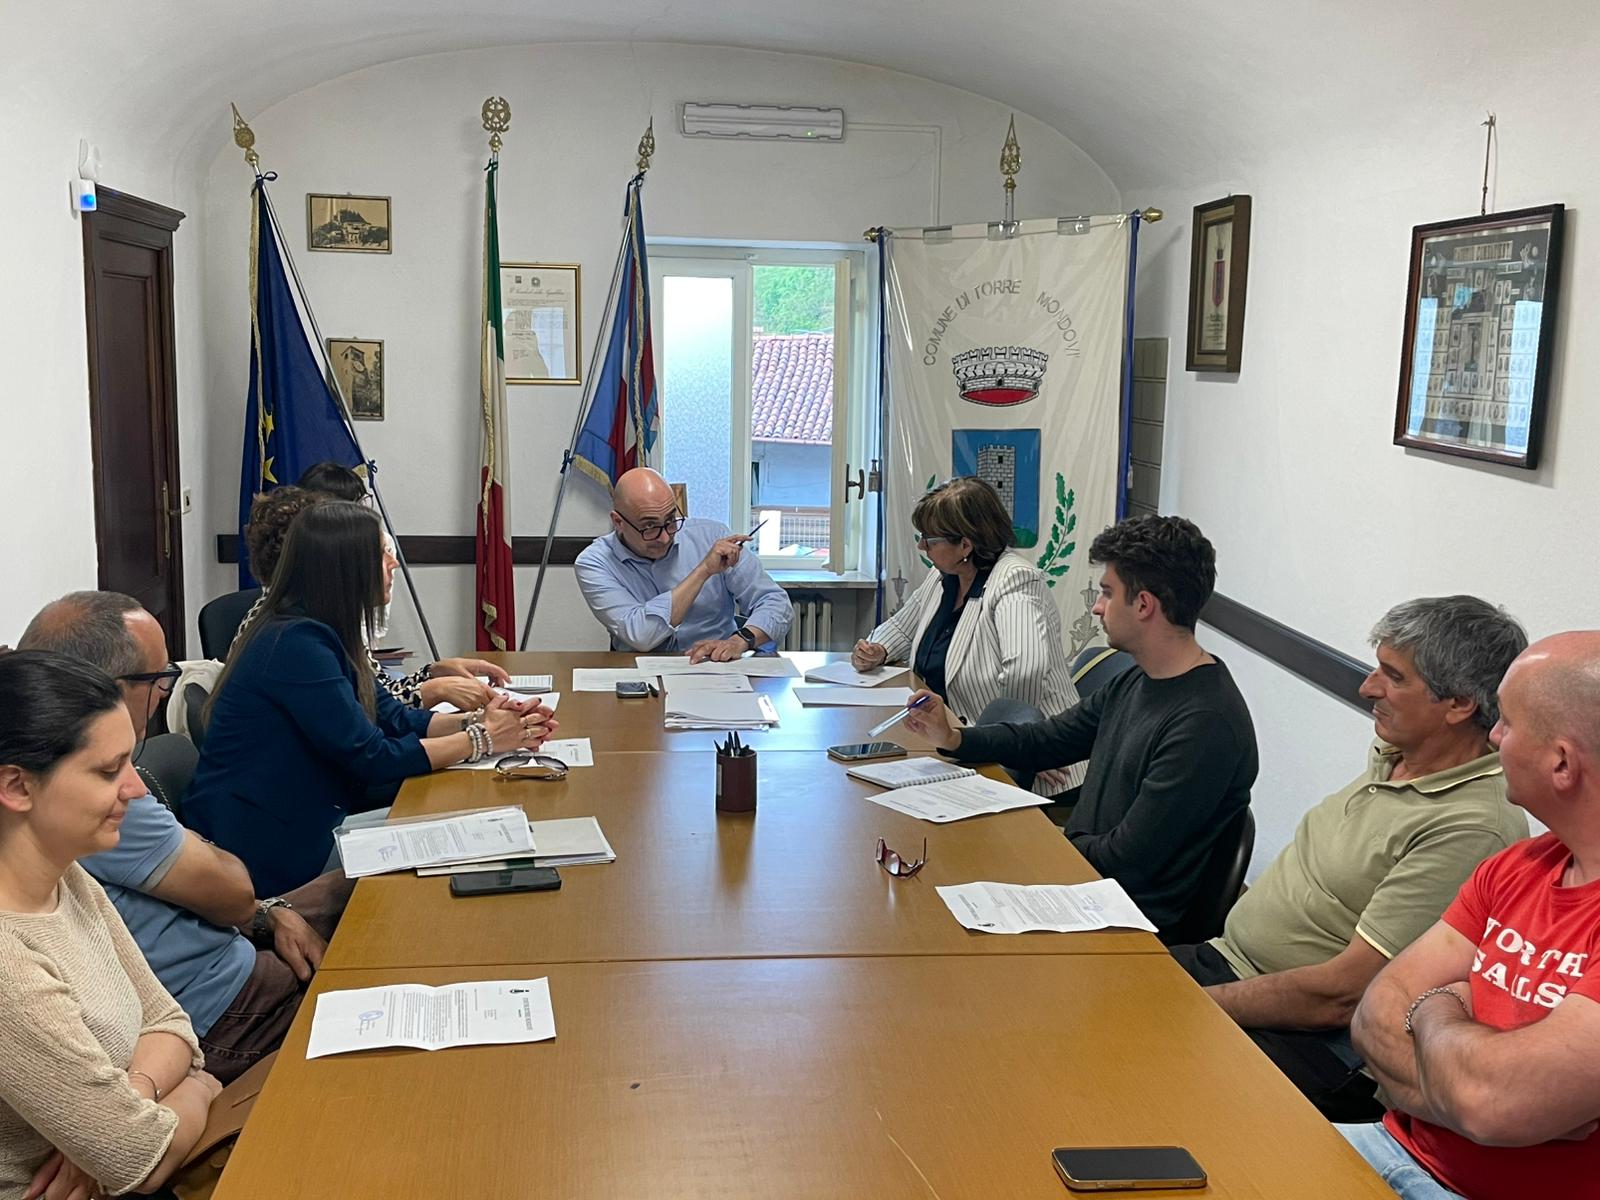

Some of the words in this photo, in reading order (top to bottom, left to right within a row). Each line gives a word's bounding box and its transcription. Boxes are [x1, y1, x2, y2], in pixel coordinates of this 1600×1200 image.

[923, 305, 958, 367] COMUNE
[955, 291, 971, 311] DI
[974, 279, 1022, 300] TORRE
